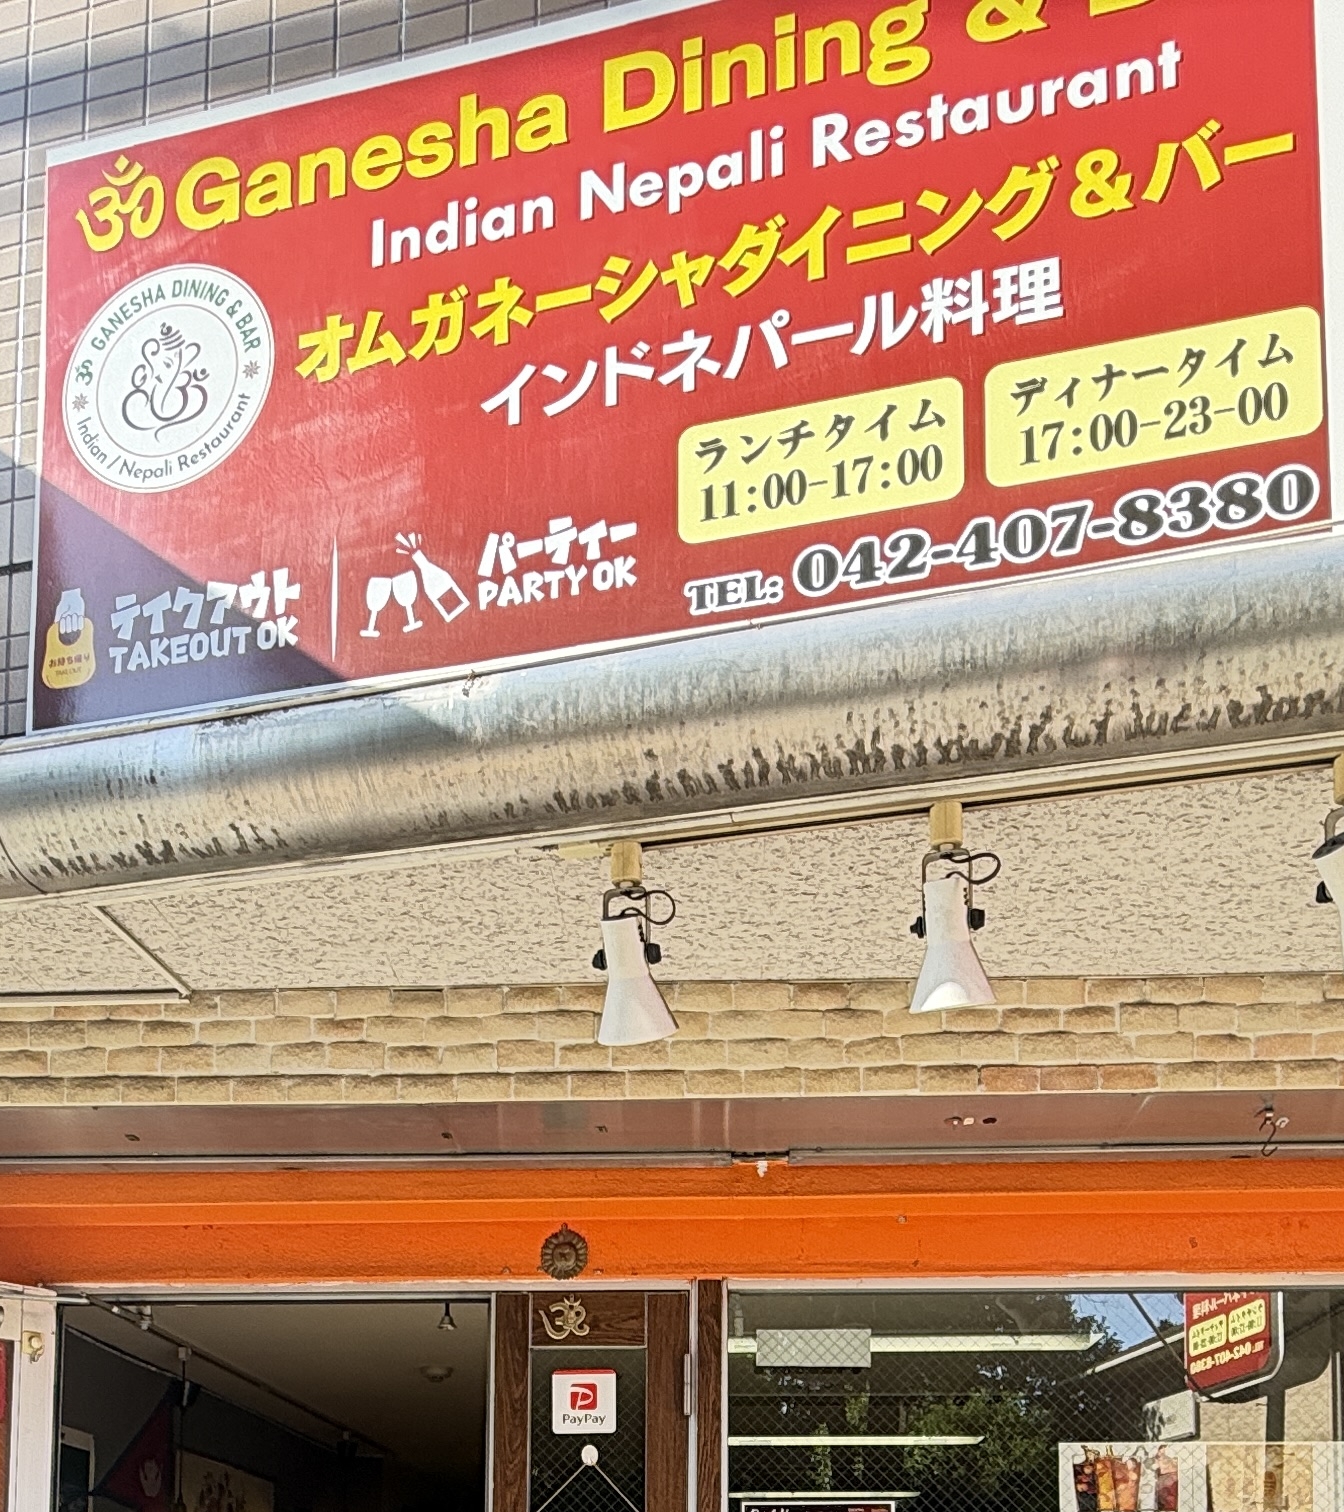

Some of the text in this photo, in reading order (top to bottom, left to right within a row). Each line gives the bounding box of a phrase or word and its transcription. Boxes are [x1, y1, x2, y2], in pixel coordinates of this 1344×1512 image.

[174, 90, 568, 232] Ganesha
[603, 0, 933, 132] Dining
[371, 41, 1182, 268] Indian Nepali Restaurant
[91, 279, 261, 353] GANESHA DINING & BAR
[480, 257, 1064, 425] インドネパール料理
[1011, 332, 1295, 416] ディナータイム
[76, 416, 107, 464] Indian
[119, 457, 173, 483] Nepali
[178, 391, 251, 471] Restaurant
[693, 398, 947, 473] ランチタイム
[1018, 381, 1289, 468] 17:00-23-00
[698, 444, 944, 523] 11:00-17:00
[478, 516, 637, 577] パーティー
[793, 464, 1320, 599] 042-407-8380
[110, 567, 300, 640] テイクアウト
[478, 557, 637, 611] PARTY OK
[109, 615, 299, 674] TAKEOUT OK
[562, 1414, 606, 1426] PayPay
